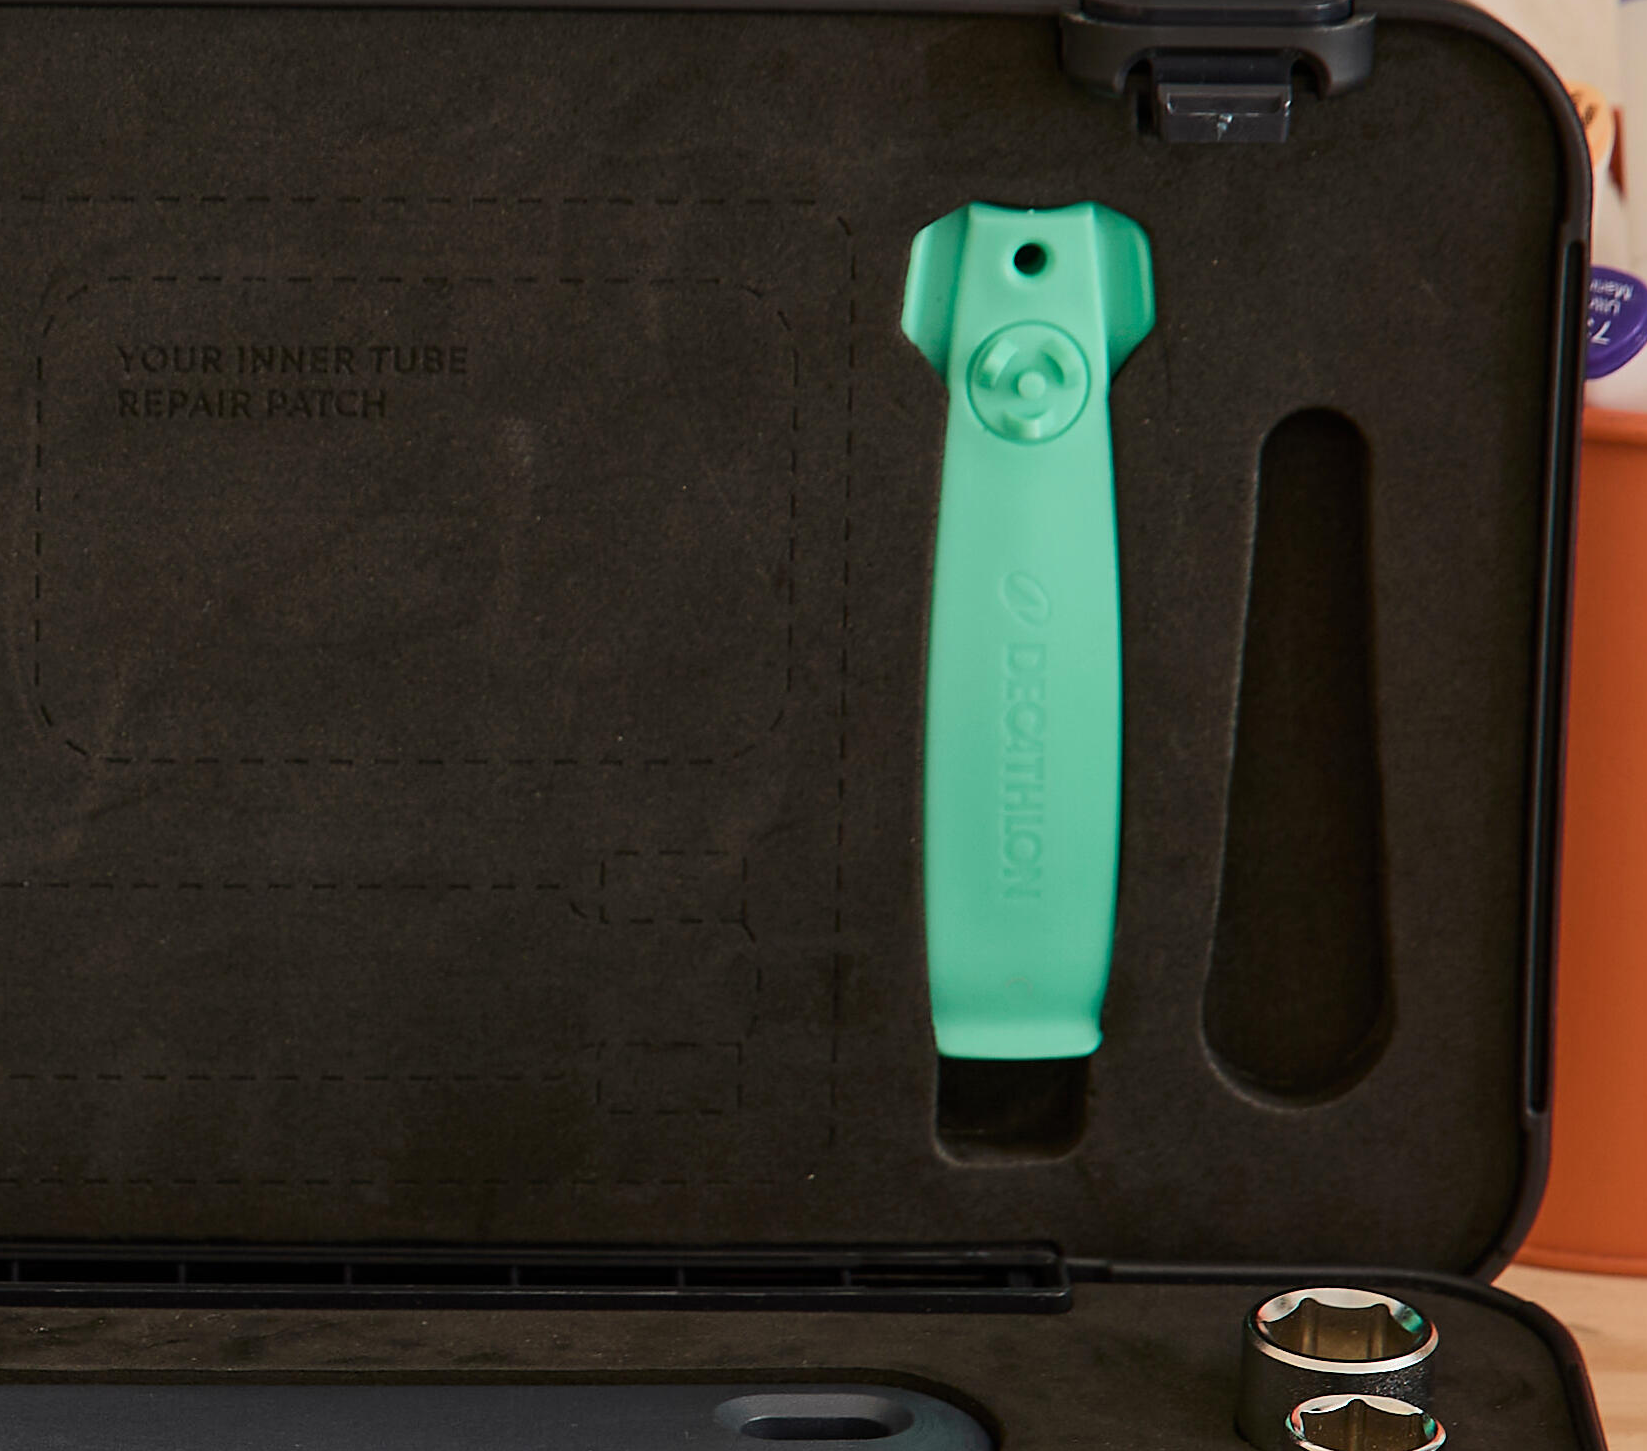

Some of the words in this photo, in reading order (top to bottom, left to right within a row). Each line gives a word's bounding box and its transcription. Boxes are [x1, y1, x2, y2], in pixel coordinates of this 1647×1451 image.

[117, 346, 223, 375] YOUR
[237, 346, 355, 376] INNER
[370, 346, 468, 376] TUBE
[117, 390, 252, 420] REPAIR
[266, 390, 387, 420] PATCH
[1003, 642, 1049, 899] DECATHLON
